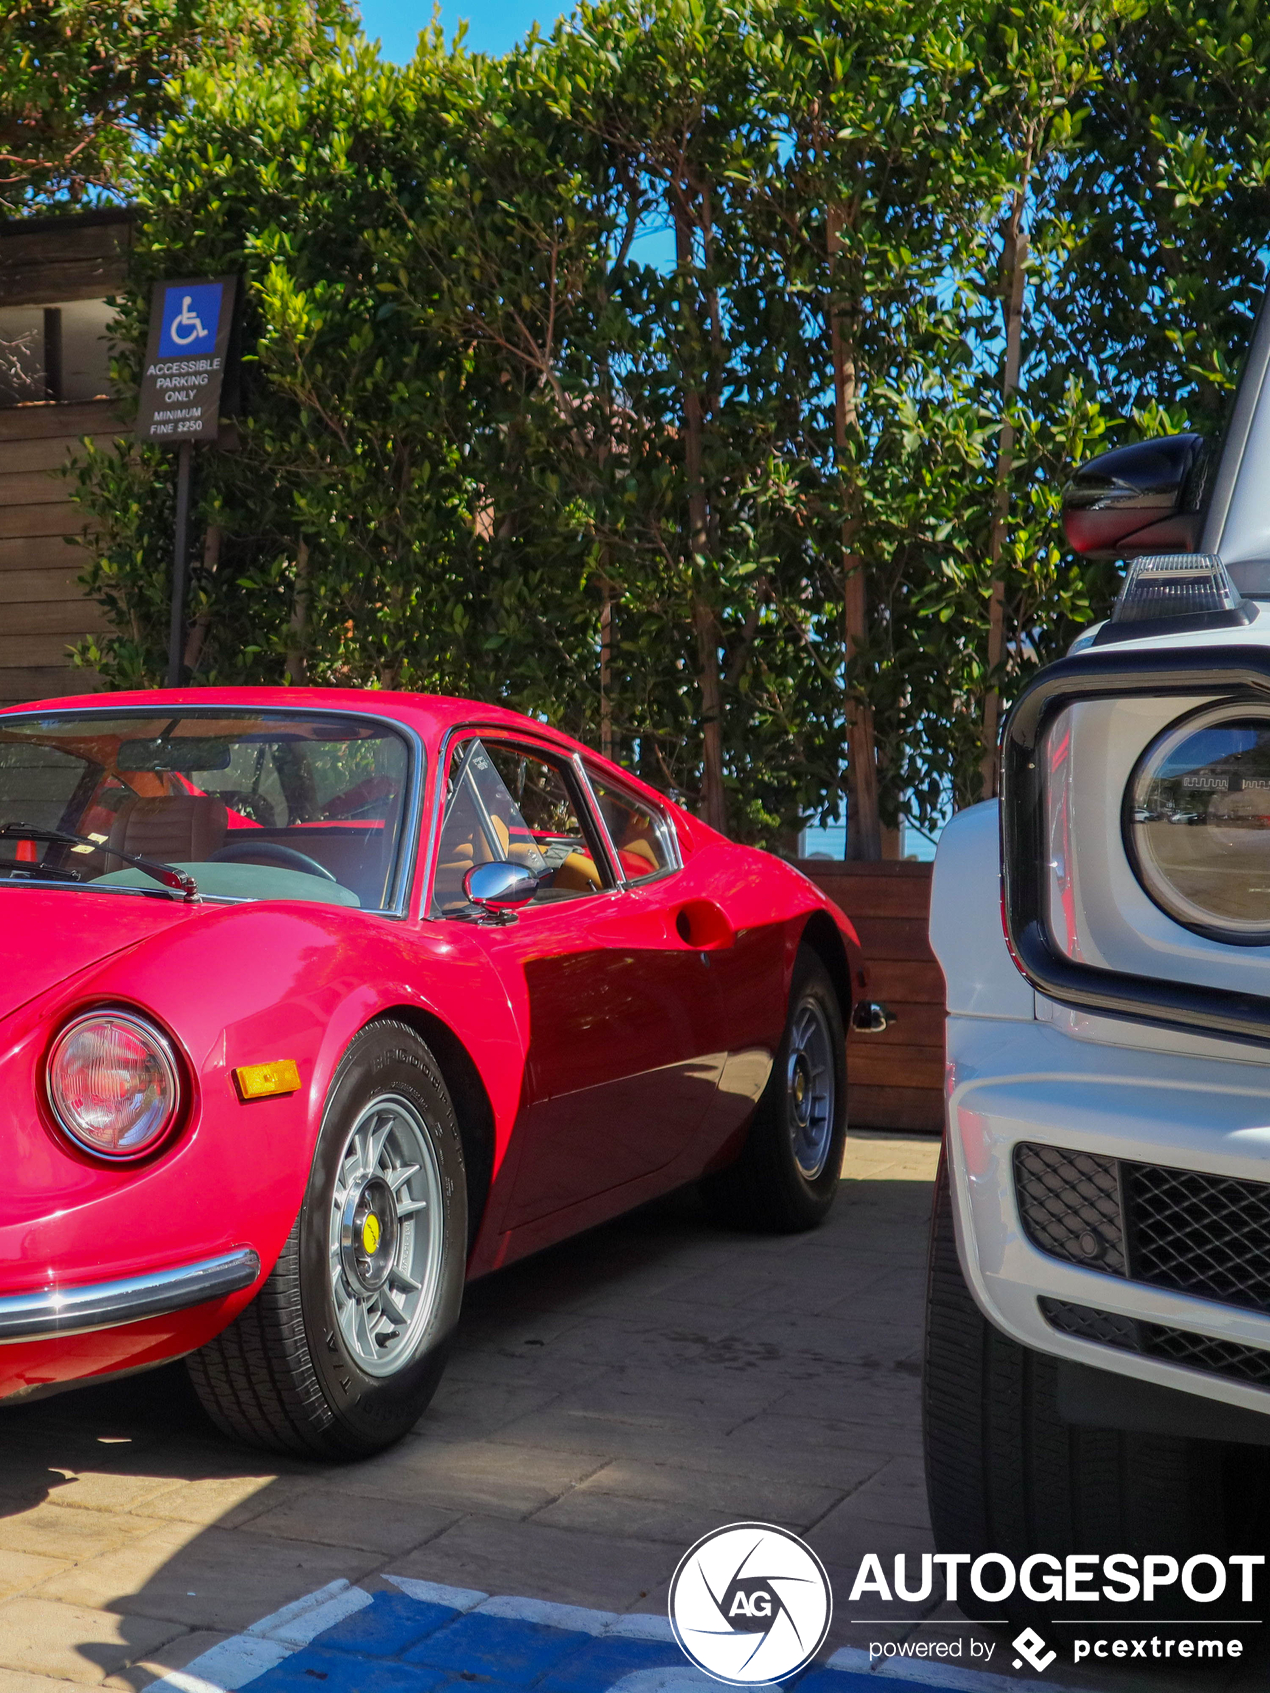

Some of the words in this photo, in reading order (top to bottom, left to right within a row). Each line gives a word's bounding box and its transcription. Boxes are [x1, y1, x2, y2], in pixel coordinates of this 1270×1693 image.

[147, 358, 221, 375] ACCESSIBLE
[156, 374, 209, 389] PARKING
[165, 390, 197, 403] ONLY
[154, 407, 201, 421] MINIMUM
[150, 423, 175, 435] FINE
[177, 420, 203, 432] $250
